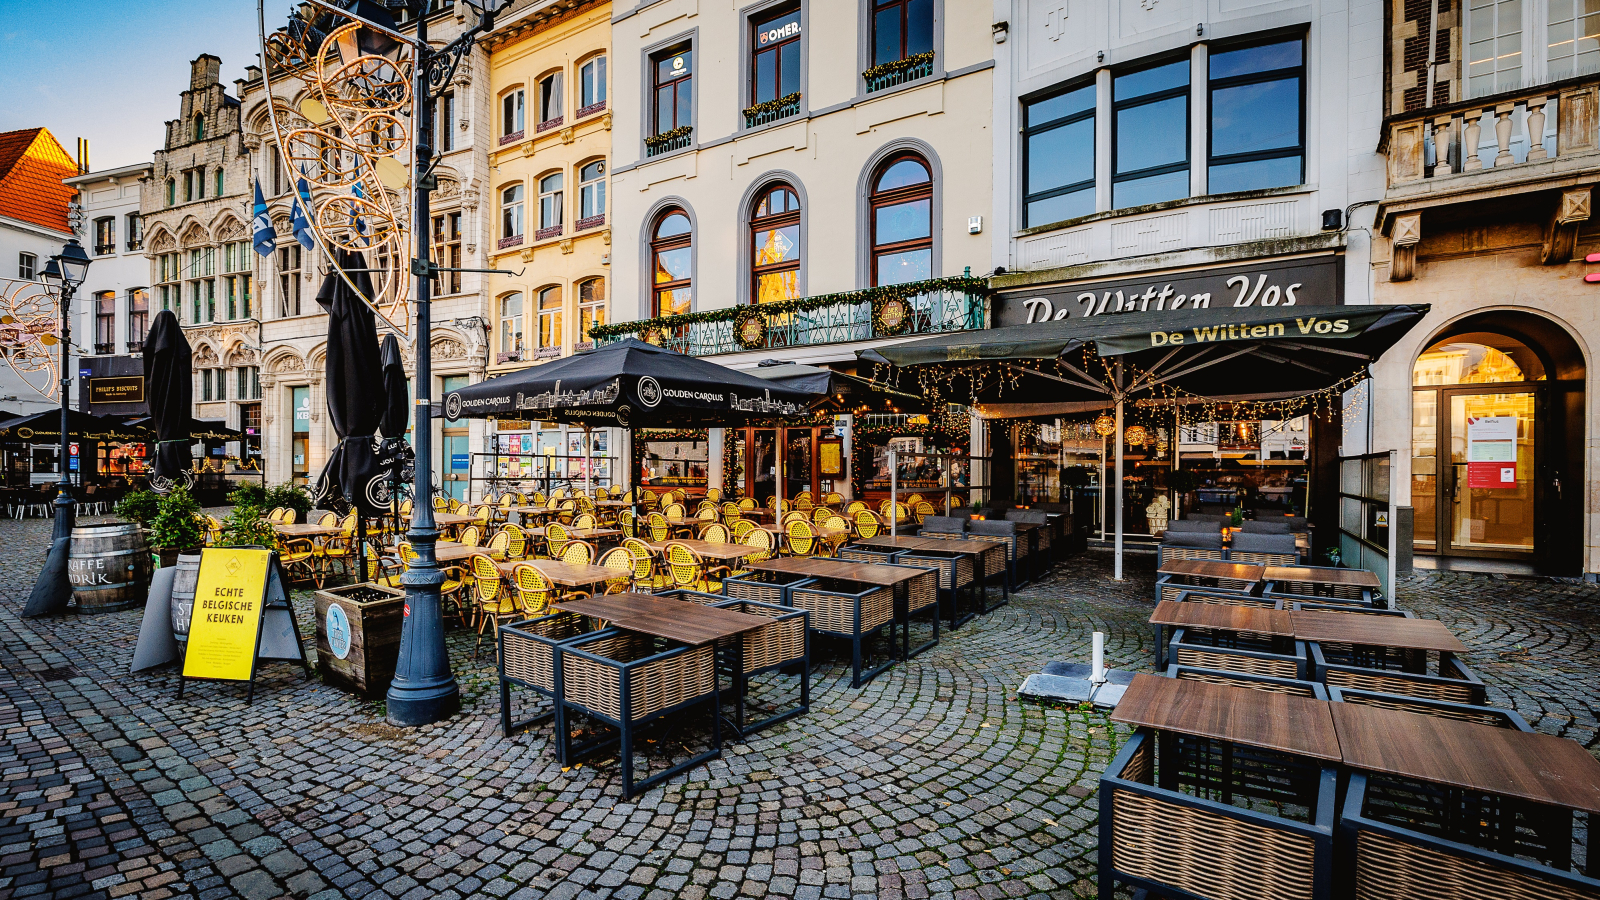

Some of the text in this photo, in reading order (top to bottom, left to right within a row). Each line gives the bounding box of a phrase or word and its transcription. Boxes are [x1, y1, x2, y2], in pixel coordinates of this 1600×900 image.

[768, 21, 802, 41] OMER.
[1022, 274, 1302, 324] De Witten Vos
[1151, 317, 1349, 347] De Witten Vos
[461, 395, 511, 408] GOUDEN CAROLUS
[662, 389, 724, 403] GOUDEN CAROLUS
[296, 411, 310, 420] KB
[68, 559, 104, 571] RAFFE
[215, 587, 244, 597] ECHTE
[178, 602, 193, 616] ST
[202, 600, 253, 611] BELGISCHE
[207, 613, 244, 624] KEUKEN
